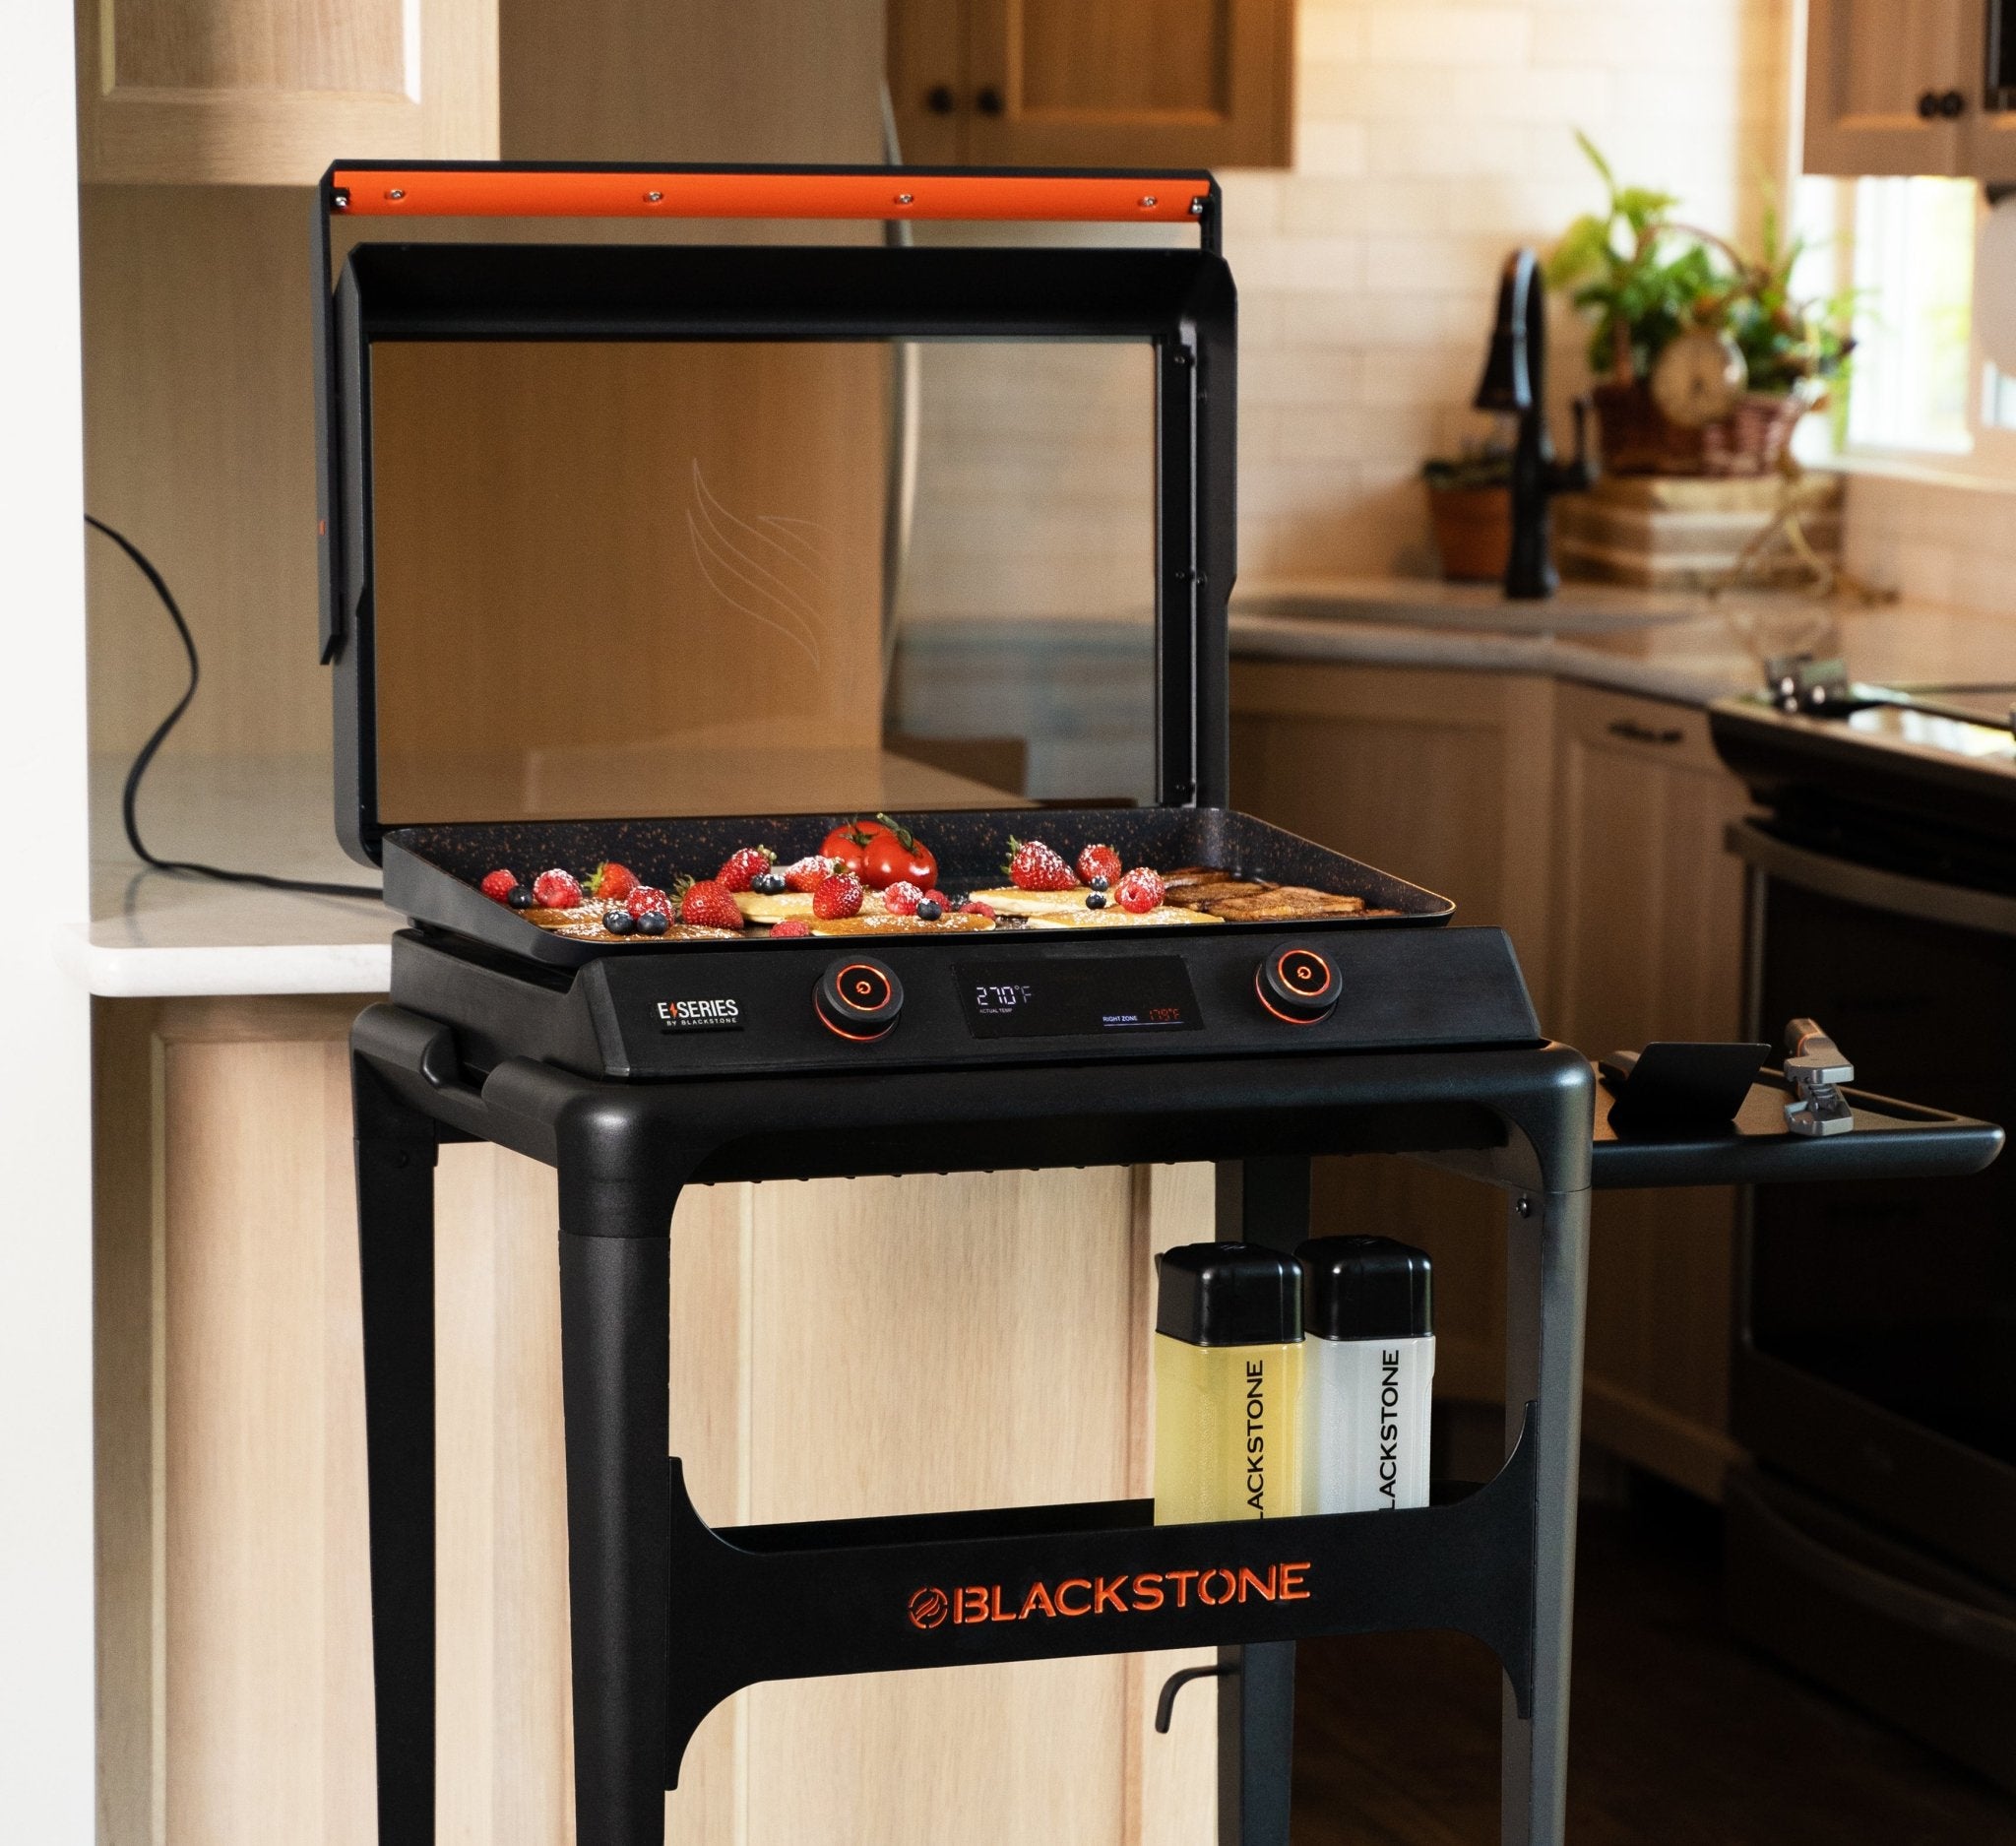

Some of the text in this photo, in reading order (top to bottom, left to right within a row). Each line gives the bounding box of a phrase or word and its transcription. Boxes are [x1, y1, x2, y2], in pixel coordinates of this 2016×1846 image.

[1246, 1360, 1264, 1520] ACKSTONE
[1378, 1349, 1400, 1512] LACKSTONE
[952, 1561, 1311, 1624] BLACKSTONE
